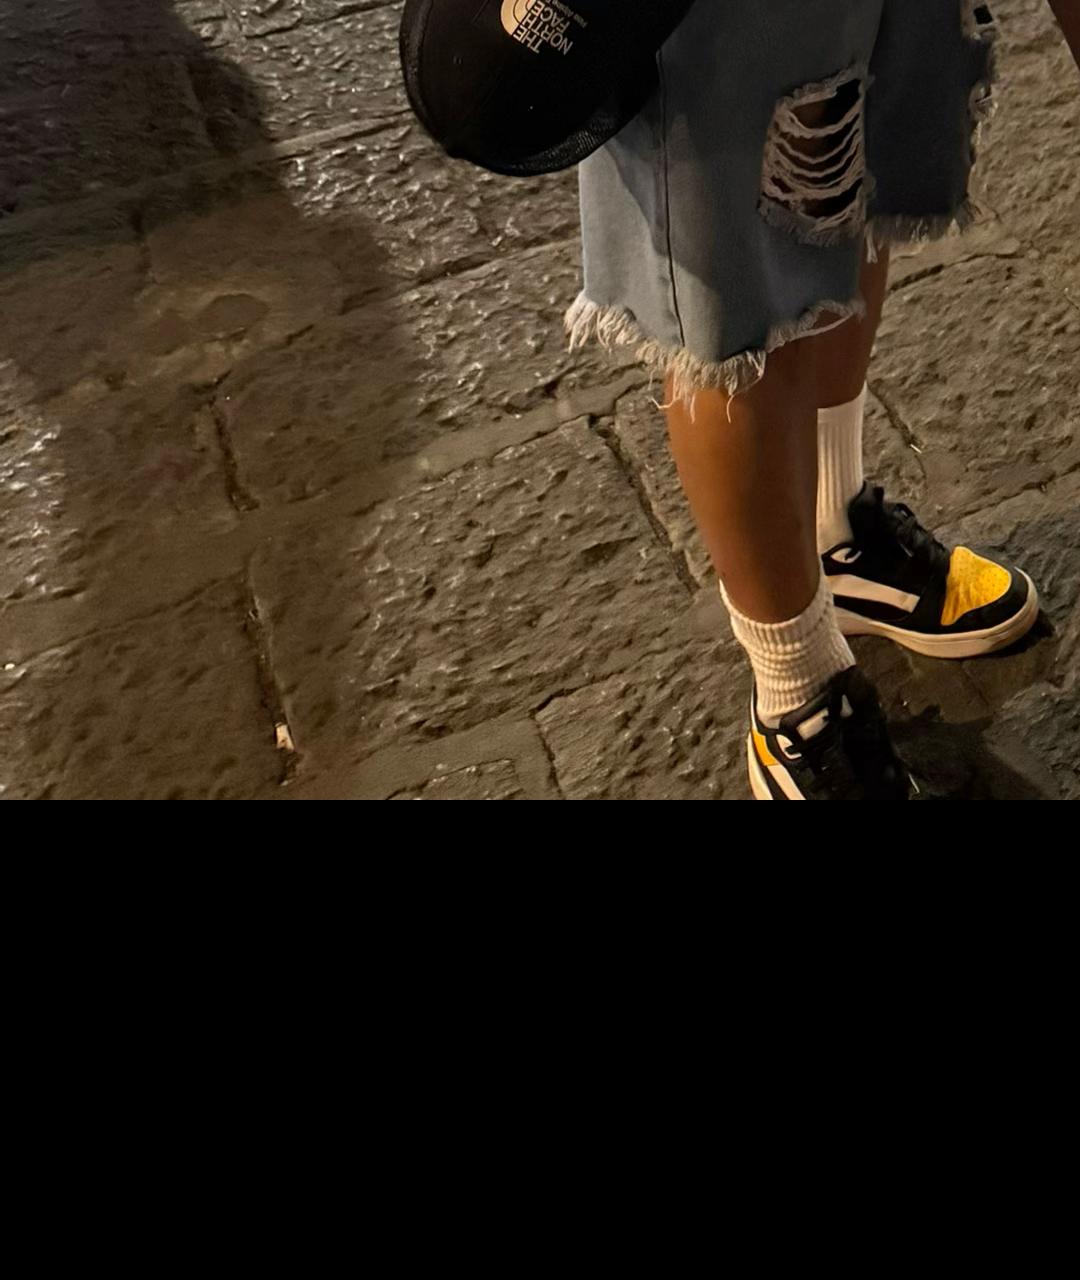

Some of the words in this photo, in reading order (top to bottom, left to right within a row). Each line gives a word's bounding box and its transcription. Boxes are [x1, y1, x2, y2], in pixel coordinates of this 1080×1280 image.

[530, 0, 571, 34] FACE
[512, 24, 543, 54] THE
[521, 13, 573, 56] NORTH
